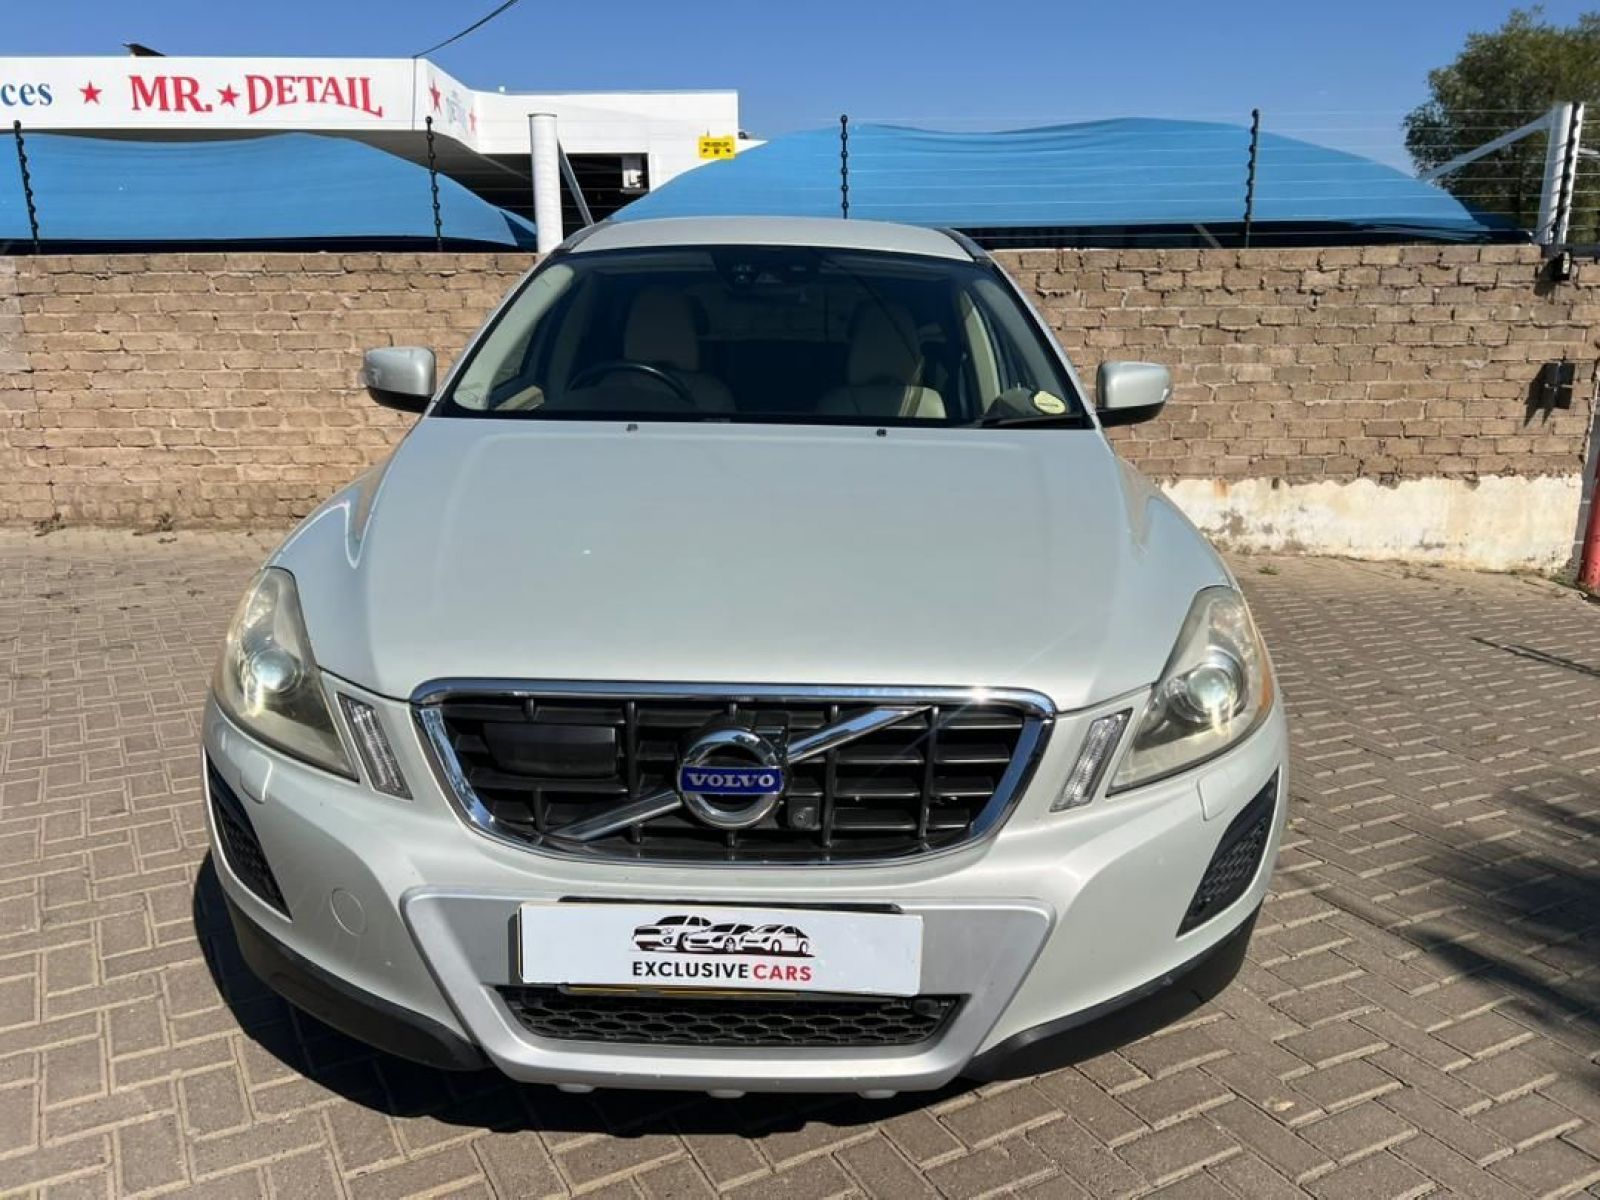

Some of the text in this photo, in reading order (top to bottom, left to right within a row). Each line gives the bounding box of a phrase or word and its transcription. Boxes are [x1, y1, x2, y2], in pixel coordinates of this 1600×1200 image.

[0, 74, 383, 118] ces MR. DETAIL
[687, 772, 776, 788] VOLVO
[632, 961, 812, 982] EXCLUSIVE CARS
